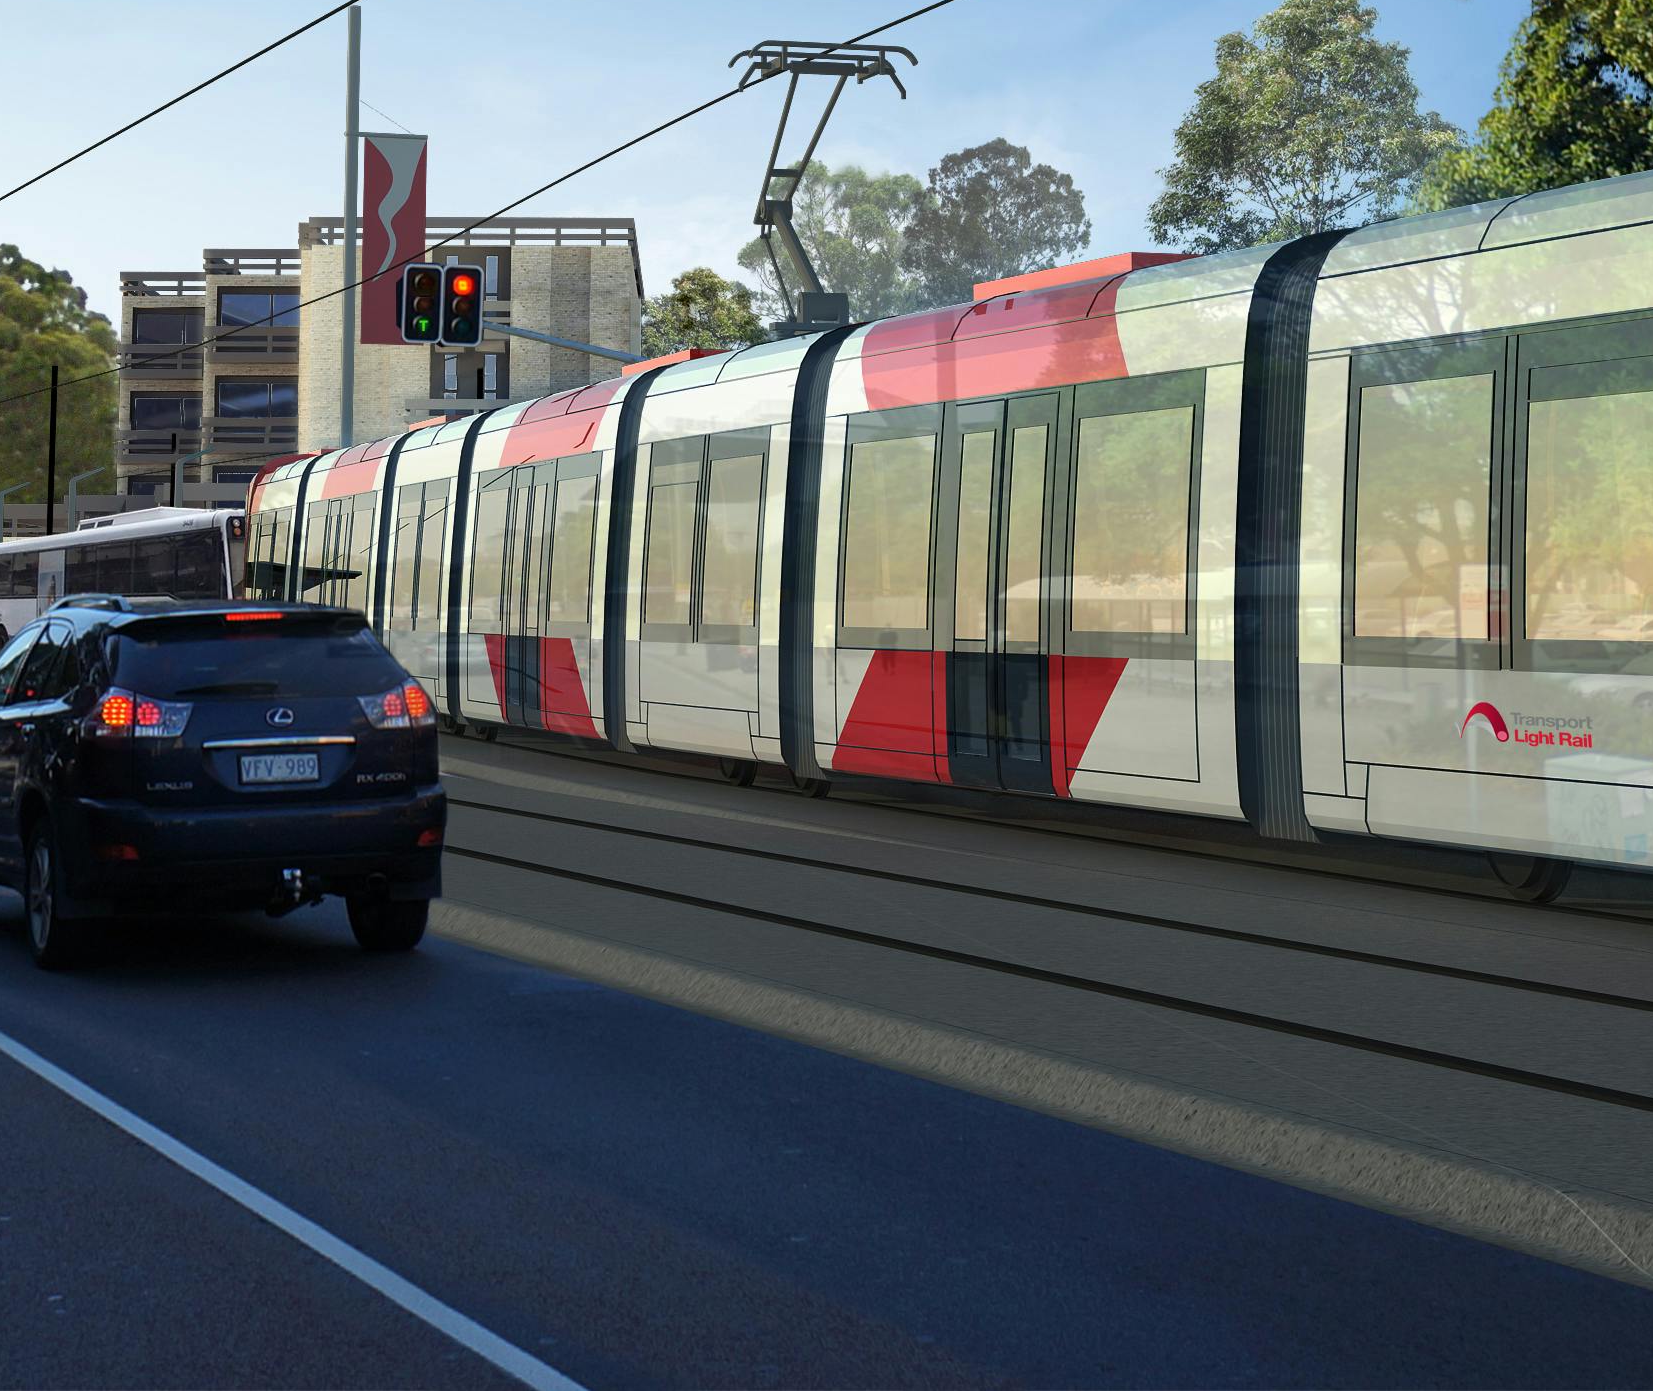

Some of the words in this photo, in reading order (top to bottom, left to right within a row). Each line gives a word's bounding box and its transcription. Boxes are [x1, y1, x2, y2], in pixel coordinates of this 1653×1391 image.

[1510, 712, 1594, 730] Transport
[1514, 729, 1555, 747] Light
[1559, 732, 1593, 749] Rail
[356, 773, 374, 784] RX
[146, 781, 194, 791] LEXUS
